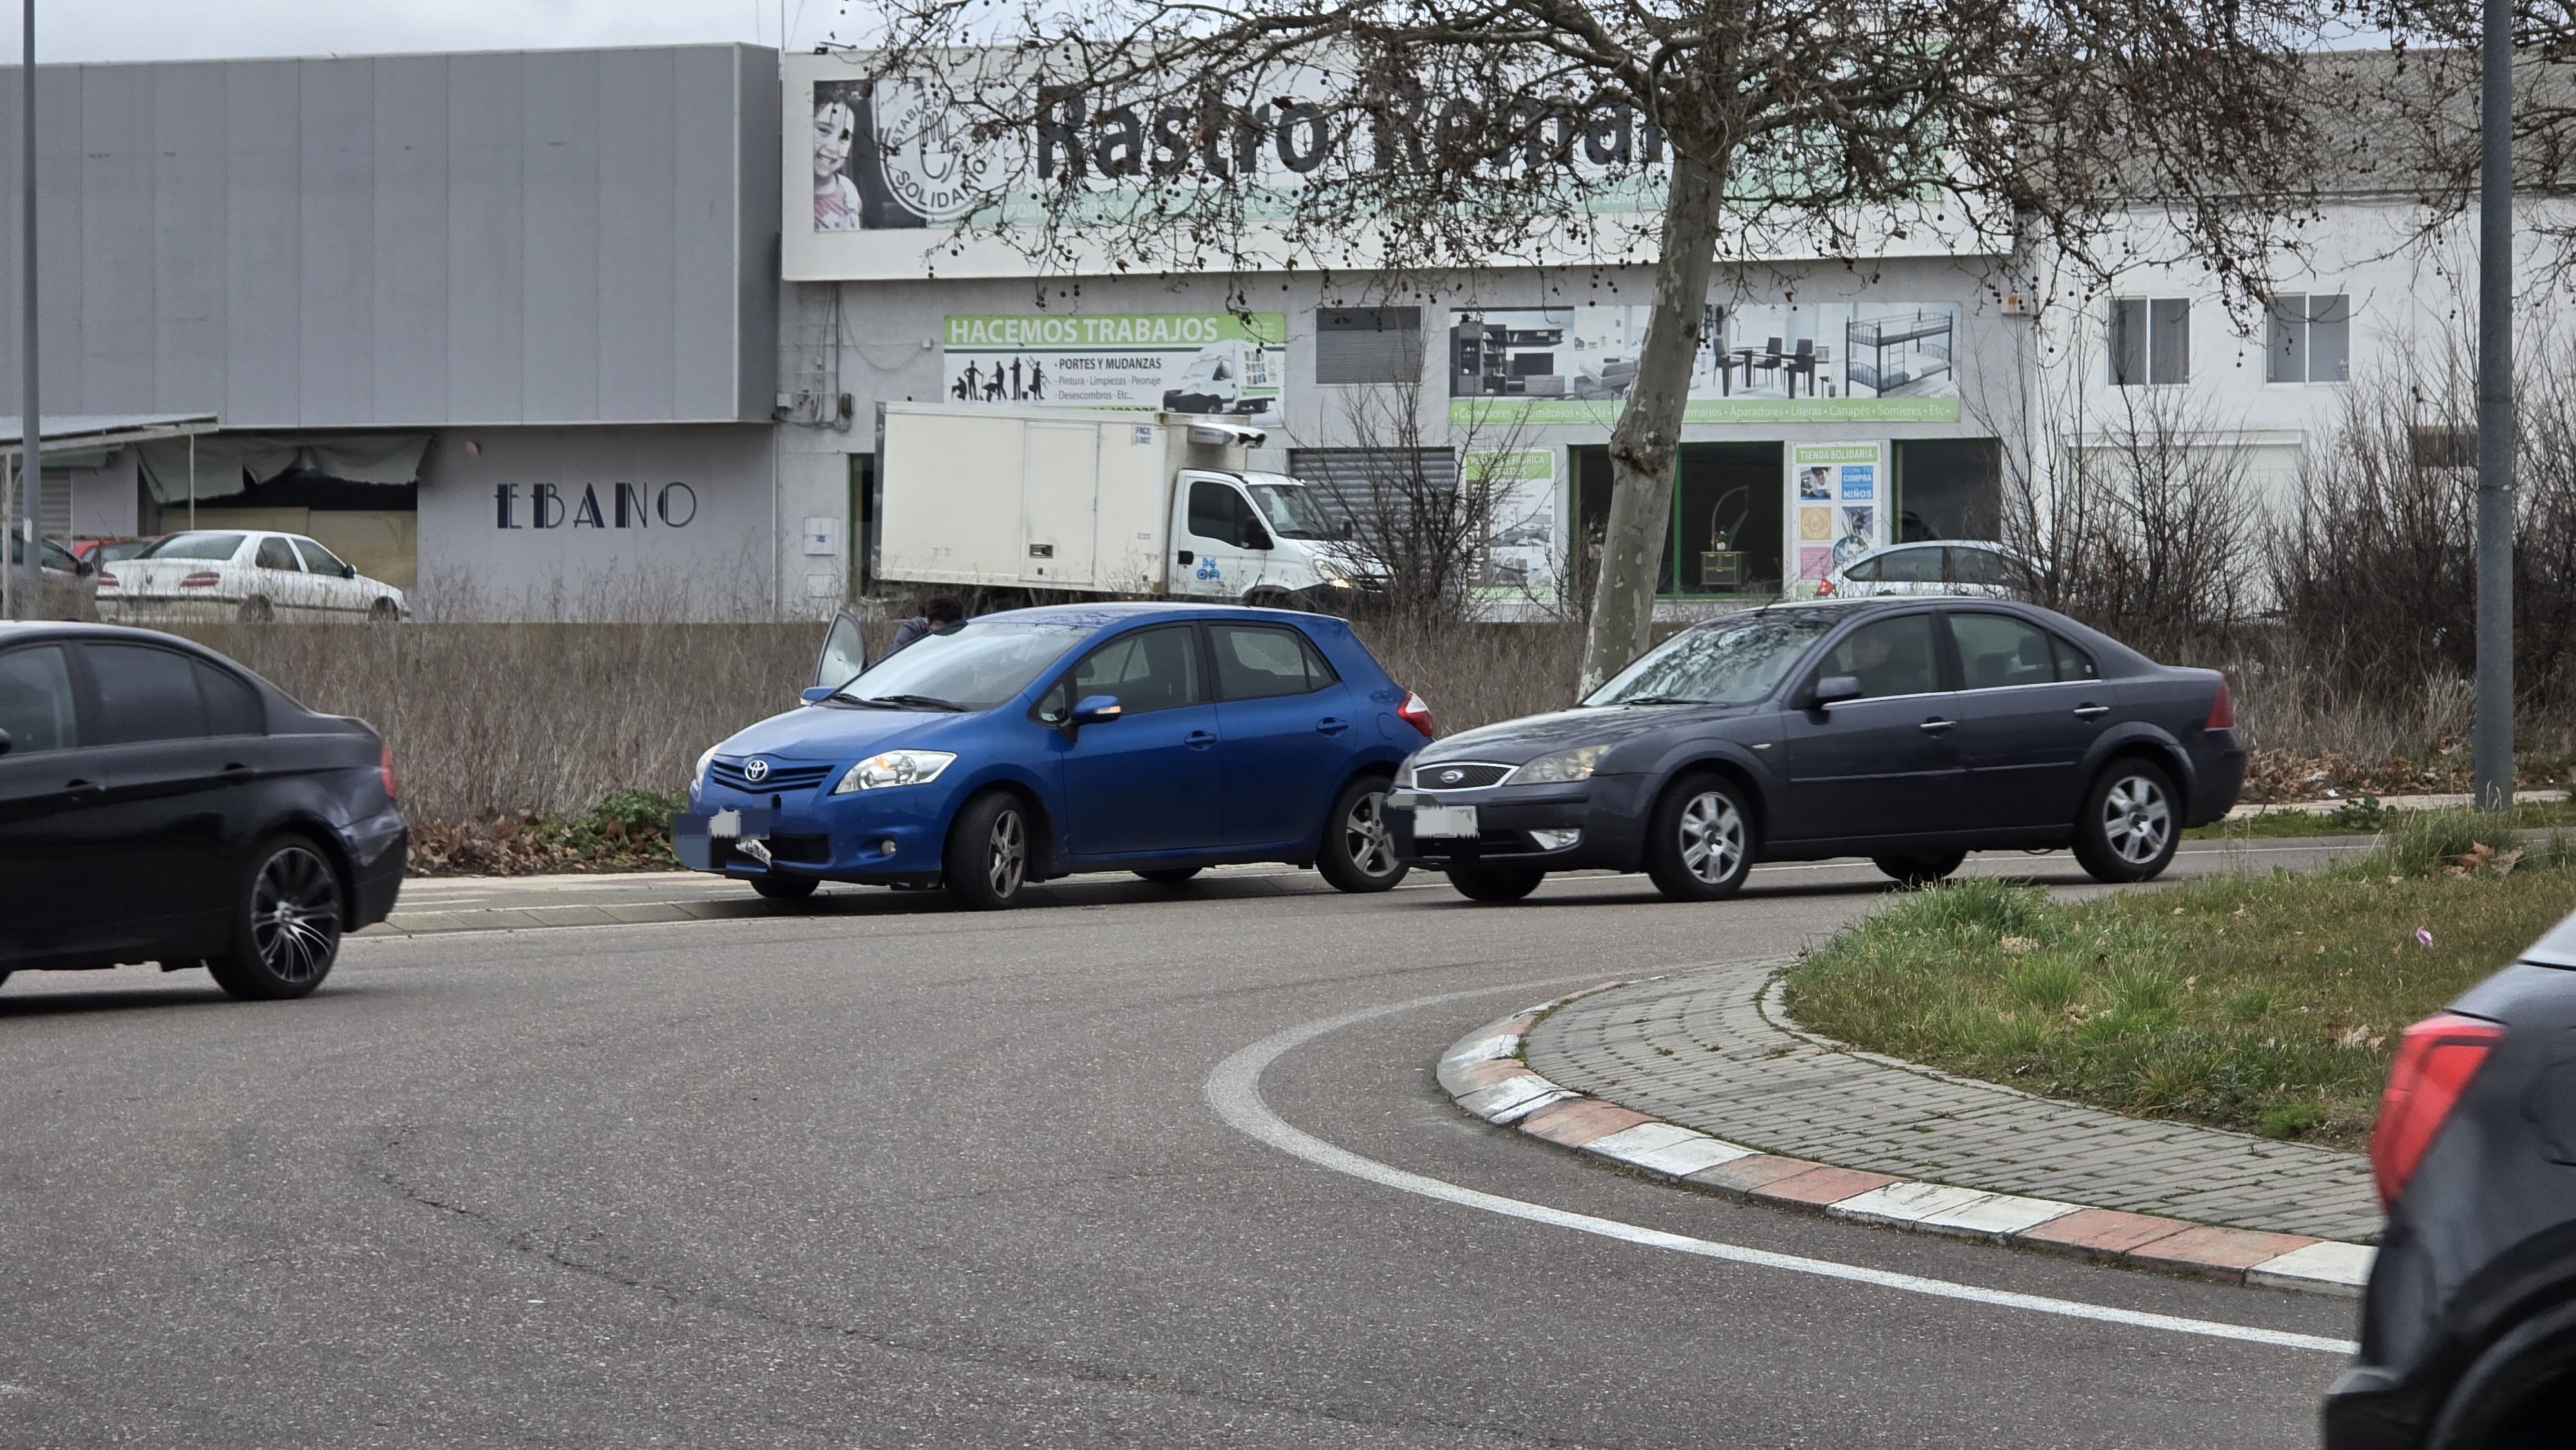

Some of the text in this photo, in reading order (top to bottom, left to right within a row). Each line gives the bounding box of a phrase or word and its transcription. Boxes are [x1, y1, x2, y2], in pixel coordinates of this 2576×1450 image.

[1036, 84, 1330, 178] Rastro
[896, 159, 987, 208] SOLIDARIO
[950, 317, 1217, 344] HACEMOS TRABAJOS
[1059, 358, 1161, 370] PORTES Y MUDANZAS
[1059, 375, 1161, 387] Pintura Limpiezas Peonaje
[1059, 390, 1112, 399] Desescombros
[1459, 408, 1512, 419] Comedores
[1520, 407, 1574, 419] Dormitorios
[1730, 406, 1783, 420] Aparadores
[1792, 404, 1823, 417] Literas
[1830, 403, 1870, 419] Canapés
[1878, 404, 1922, 417] Somieres
[1929, 404, 1945, 417] Etc
[1801, 449, 1874, 460] TIENDA SOLIDARIA
[1843, 473, 1872, 482] COMPRA
[1843, 487, 1872, 498] NIÑOS
[494, 482, 697, 529] EBANO
